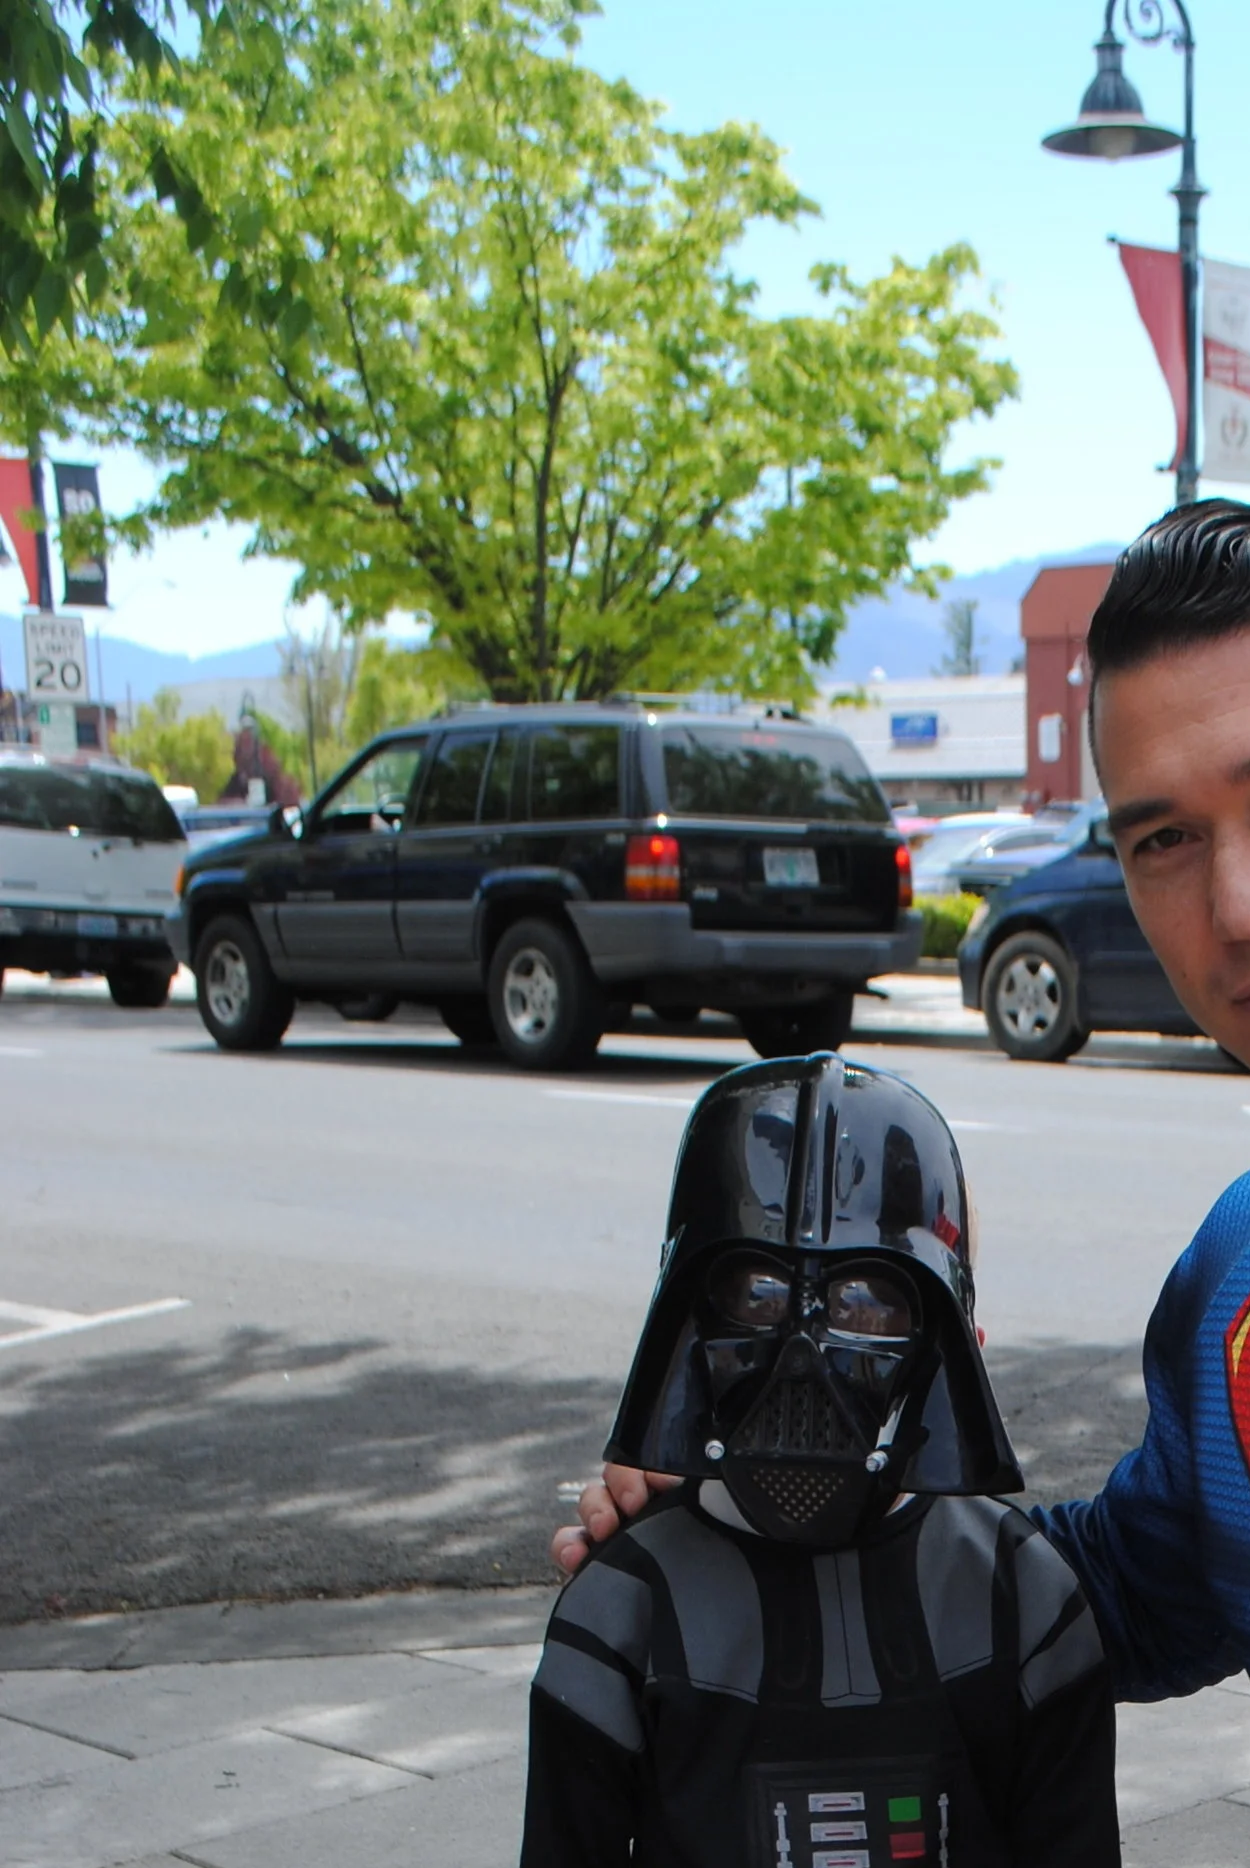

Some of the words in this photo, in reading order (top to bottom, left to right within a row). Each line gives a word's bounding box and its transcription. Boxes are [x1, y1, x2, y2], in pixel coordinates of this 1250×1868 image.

[30, 623, 80, 638] SPEED
[36, 642, 75, 656] LIMIT
[34, 659, 81, 691] 20
